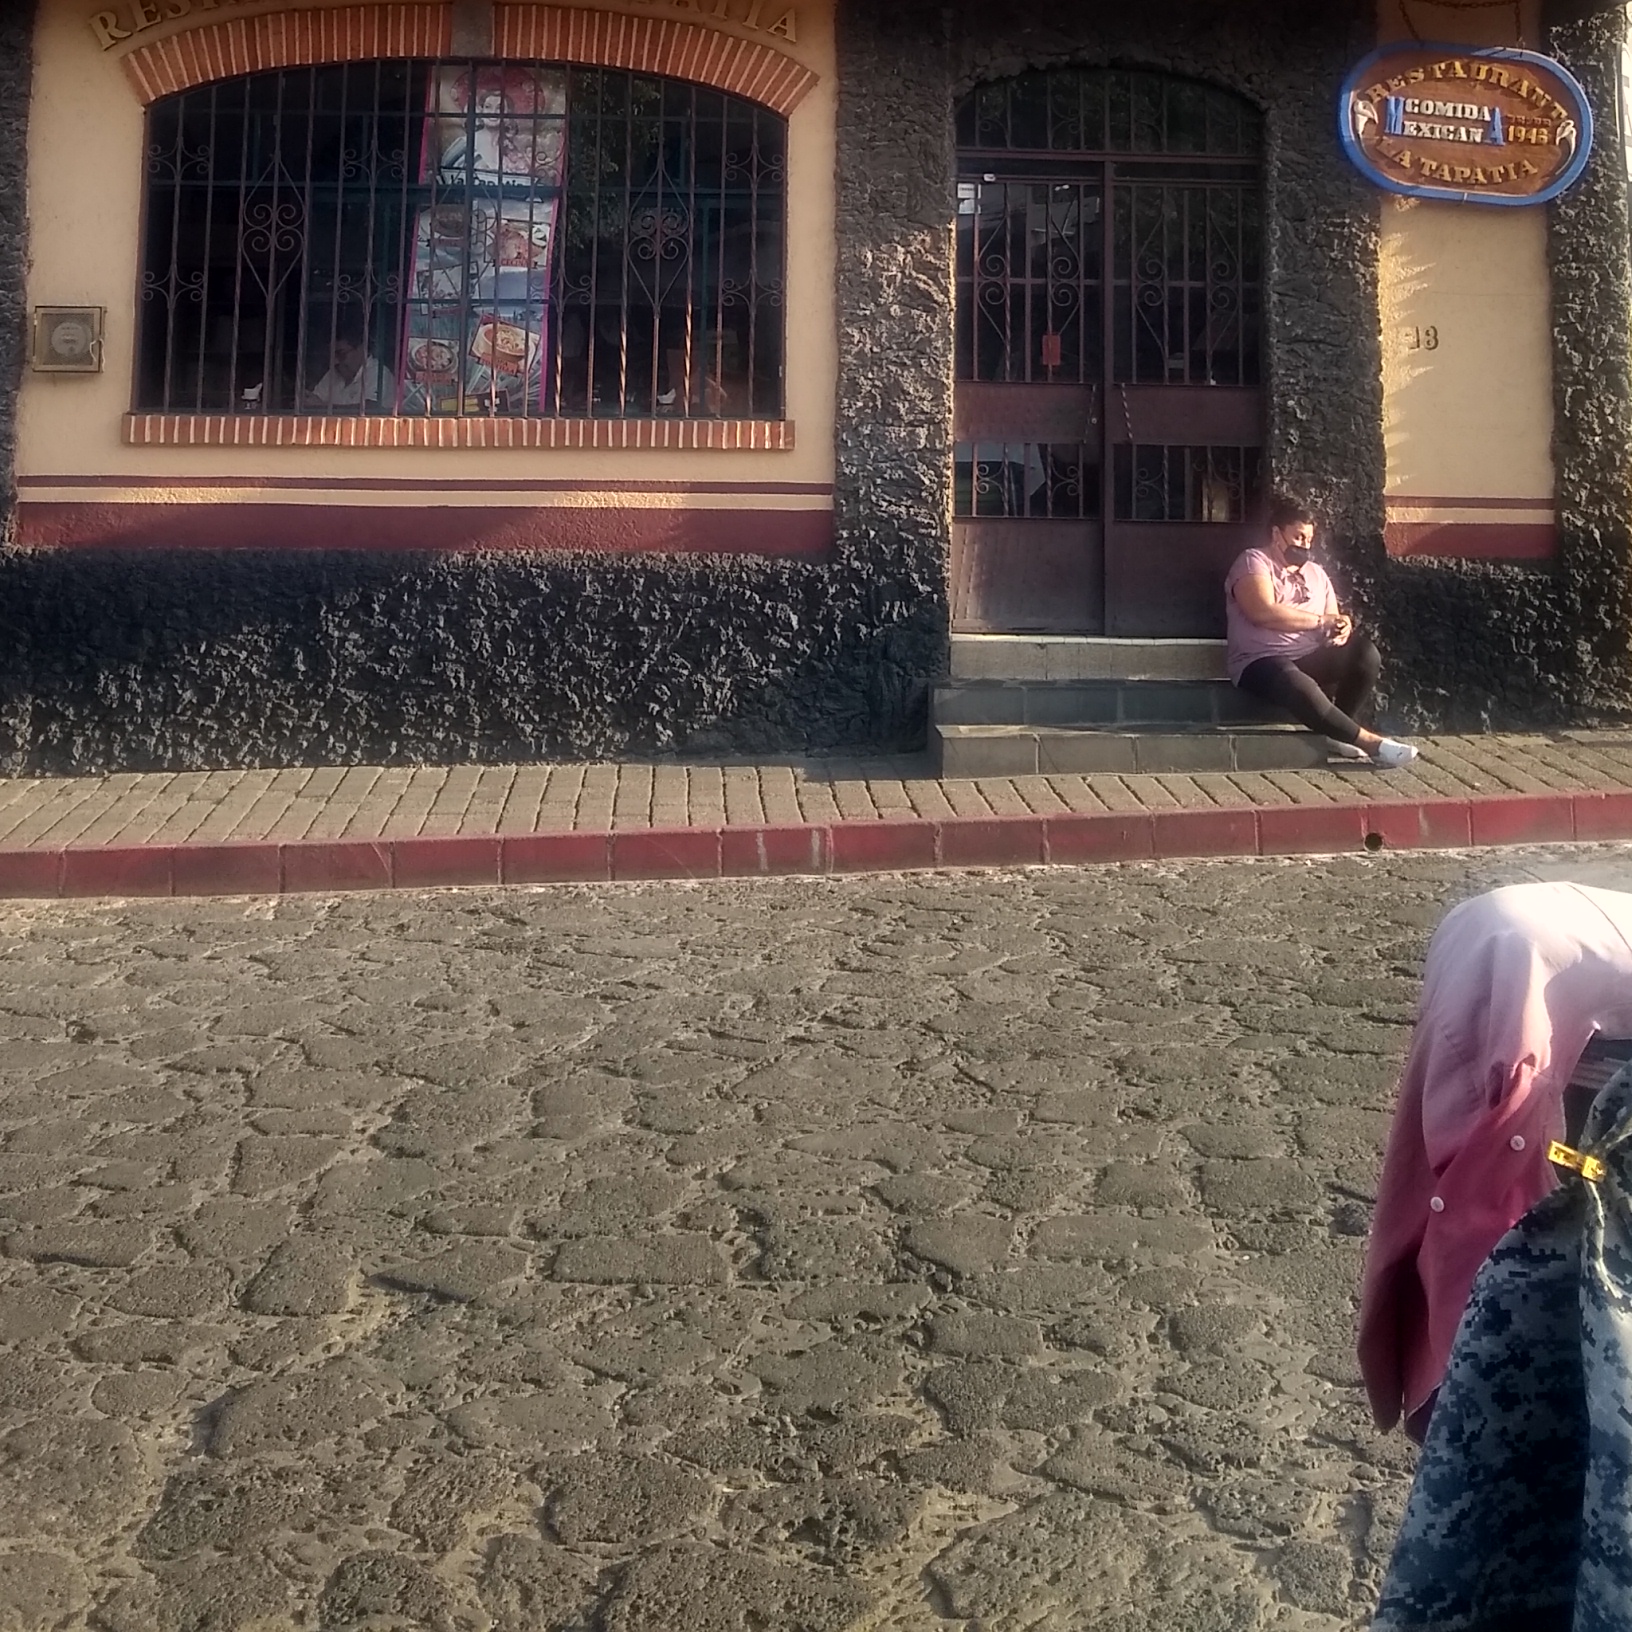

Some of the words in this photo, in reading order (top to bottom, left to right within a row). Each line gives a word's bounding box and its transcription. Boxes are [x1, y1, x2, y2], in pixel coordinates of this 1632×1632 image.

[1364, 60, 1568, 119] RESTAURANT
[1405, 98, 1491, 121] COMIDA
[1376, 137, 1412, 168] LA
[1420, 157, 1538, 184] TAPATIA
